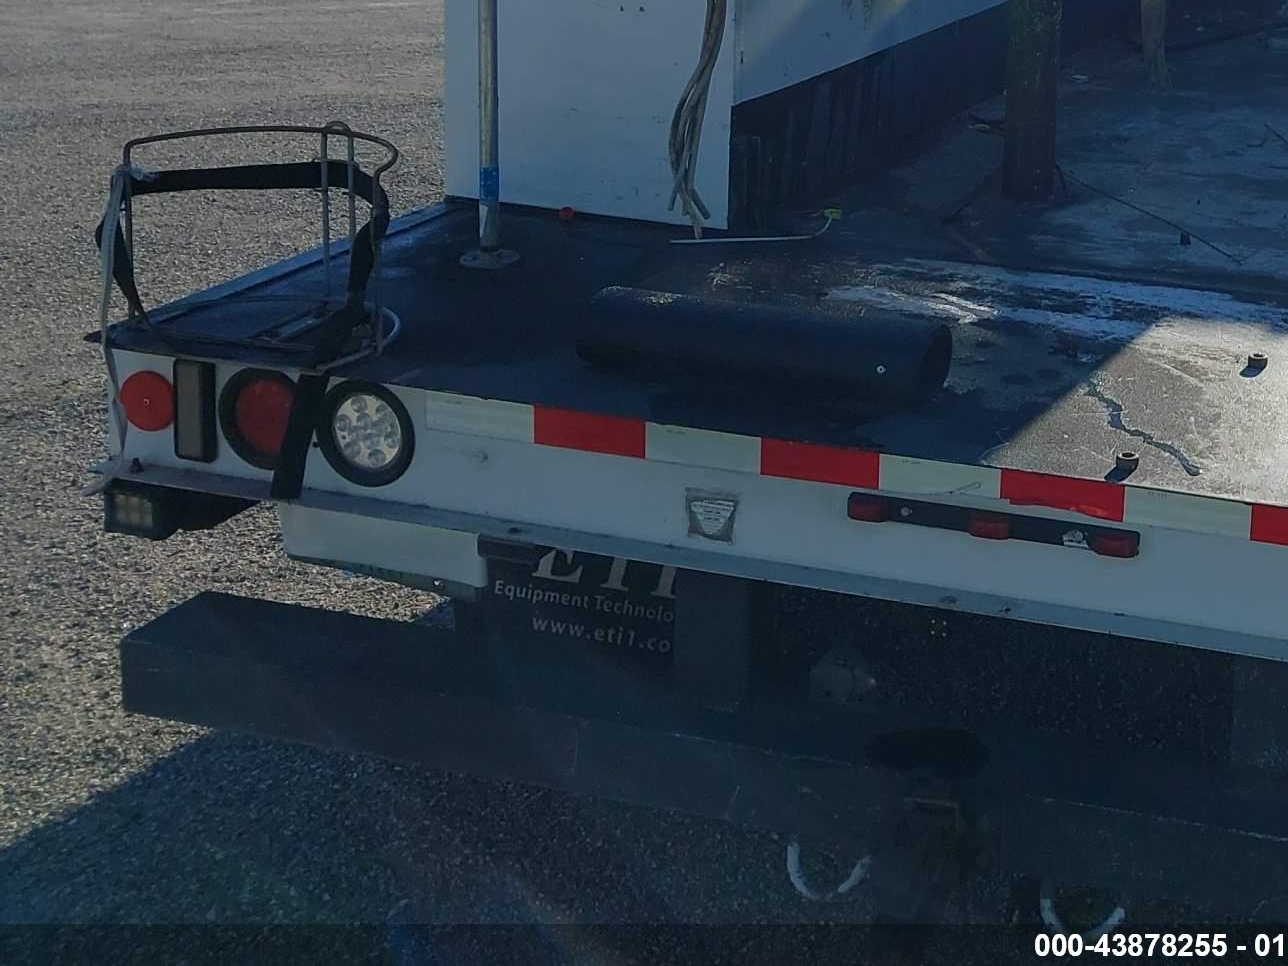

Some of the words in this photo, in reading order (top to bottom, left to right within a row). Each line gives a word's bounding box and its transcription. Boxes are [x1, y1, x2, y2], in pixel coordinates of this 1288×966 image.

[493, 579, 591, 610] Equipment
[593, 595, 674, 623] Technolo
[532, 616, 671, 653] www.eti1.co
